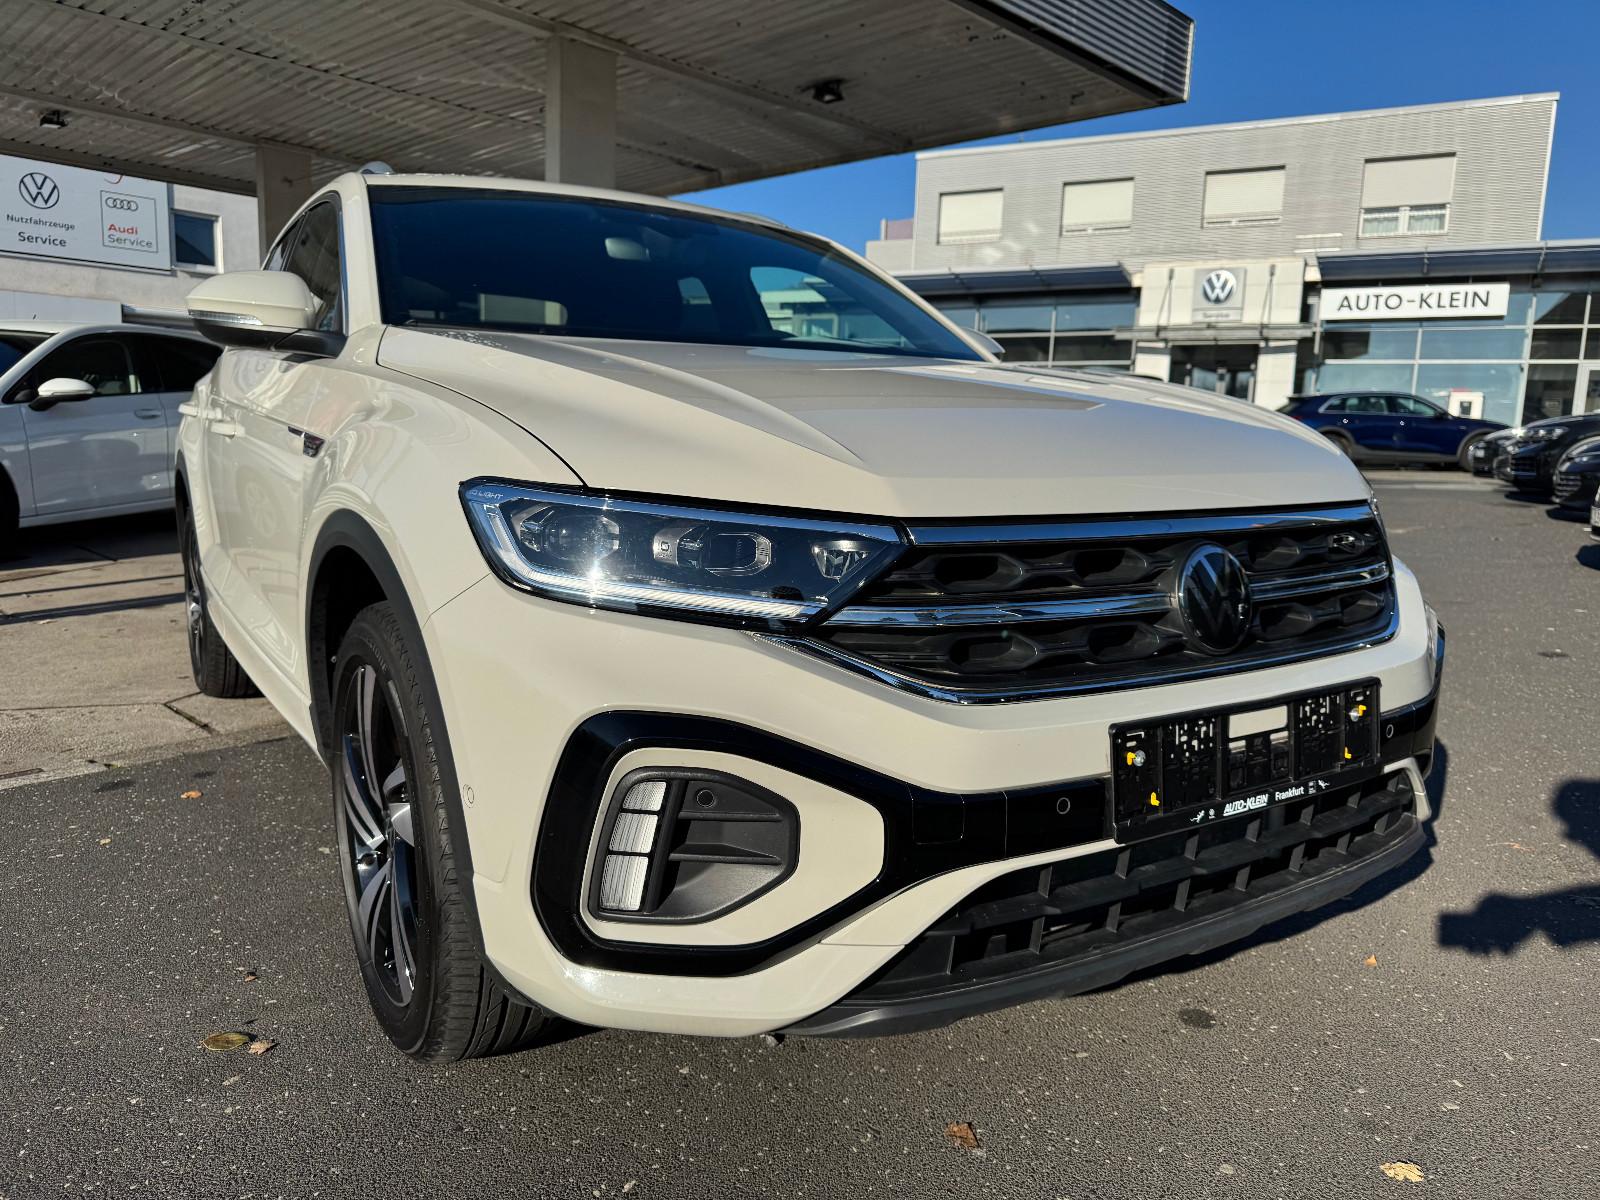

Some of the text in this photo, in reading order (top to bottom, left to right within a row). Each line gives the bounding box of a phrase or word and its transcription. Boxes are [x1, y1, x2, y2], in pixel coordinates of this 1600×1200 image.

[6, 214, 75, 230] Nutzfahrzeuge
[108, 224, 138, 235] Audi
[17, 231, 67, 247] Service
[107, 234, 153, 248] Service
[1336, 290, 1490, 312] AUTO-KLEIN
[1223, 794, 1268, 816] AUTO-KLEIN
[1275, 786, 1304, 800] Frankfurt
